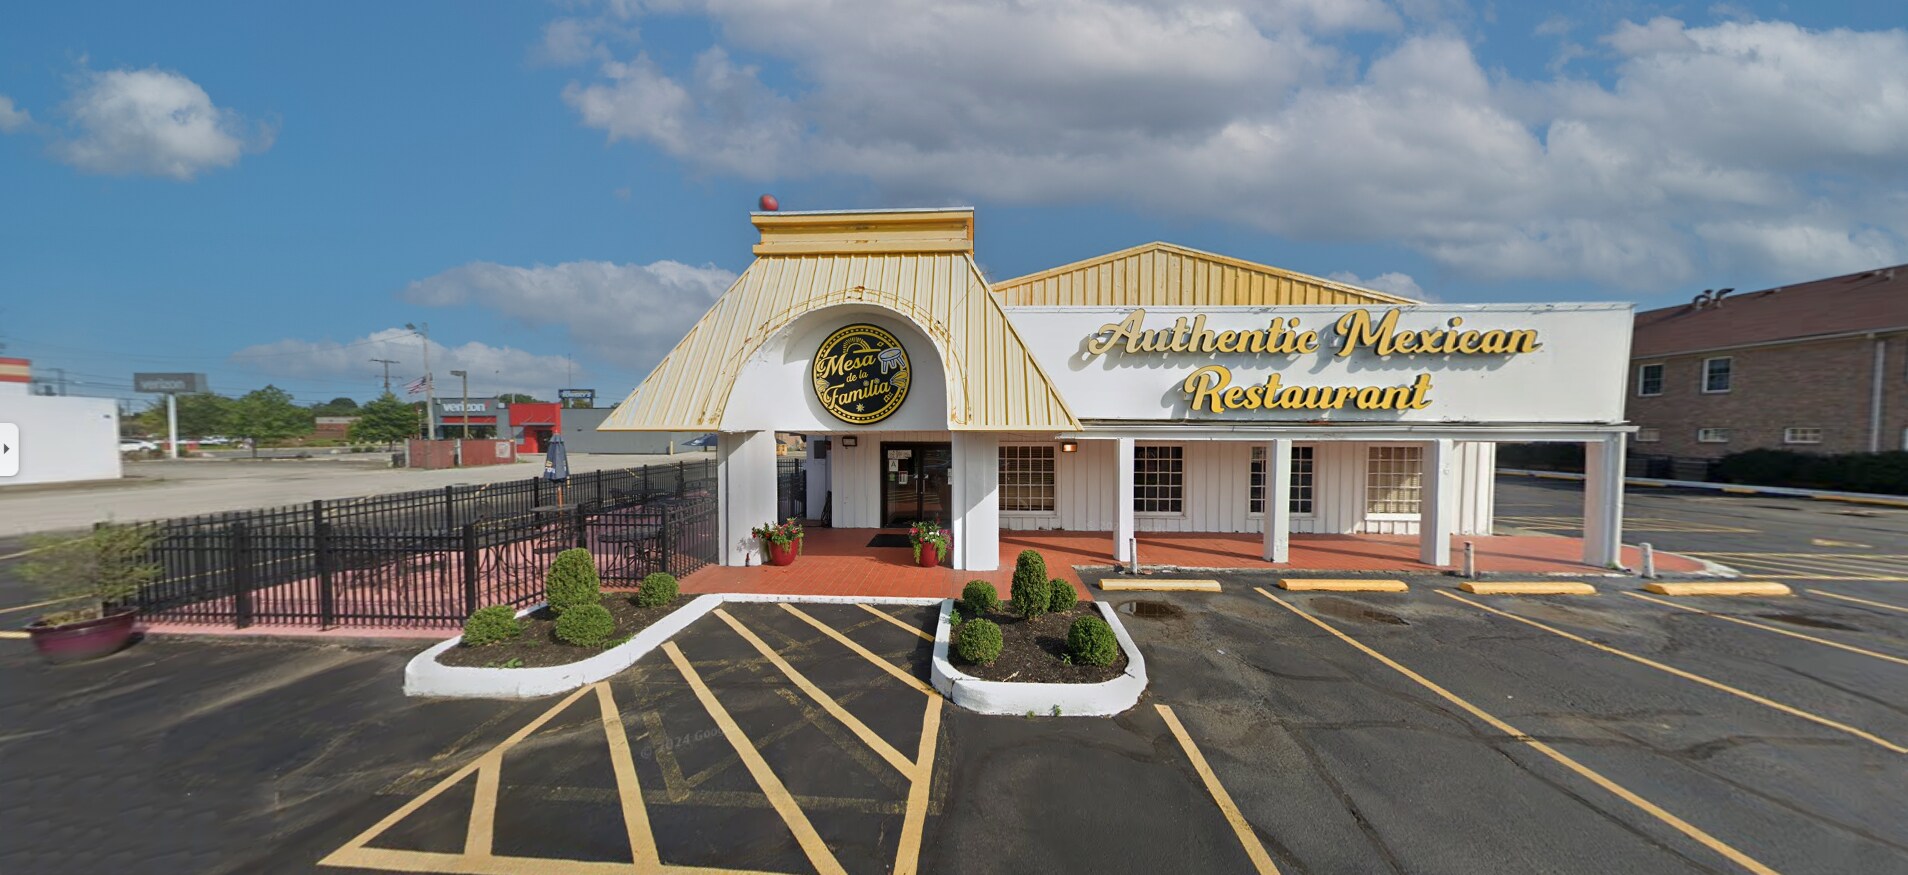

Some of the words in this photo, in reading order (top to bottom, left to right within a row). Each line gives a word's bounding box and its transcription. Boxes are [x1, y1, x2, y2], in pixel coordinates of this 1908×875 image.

[1088, 308, 1319, 355] Authentic
[1336, 308, 1541, 357] Mexican
[816, 353, 876, 378] Mesa
[846, 372, 858, 383] de
[858, 369, 869, 380] la
[823, 378, 892, 411] Familia
[1183, 364, 1433, 413] Restaurant
